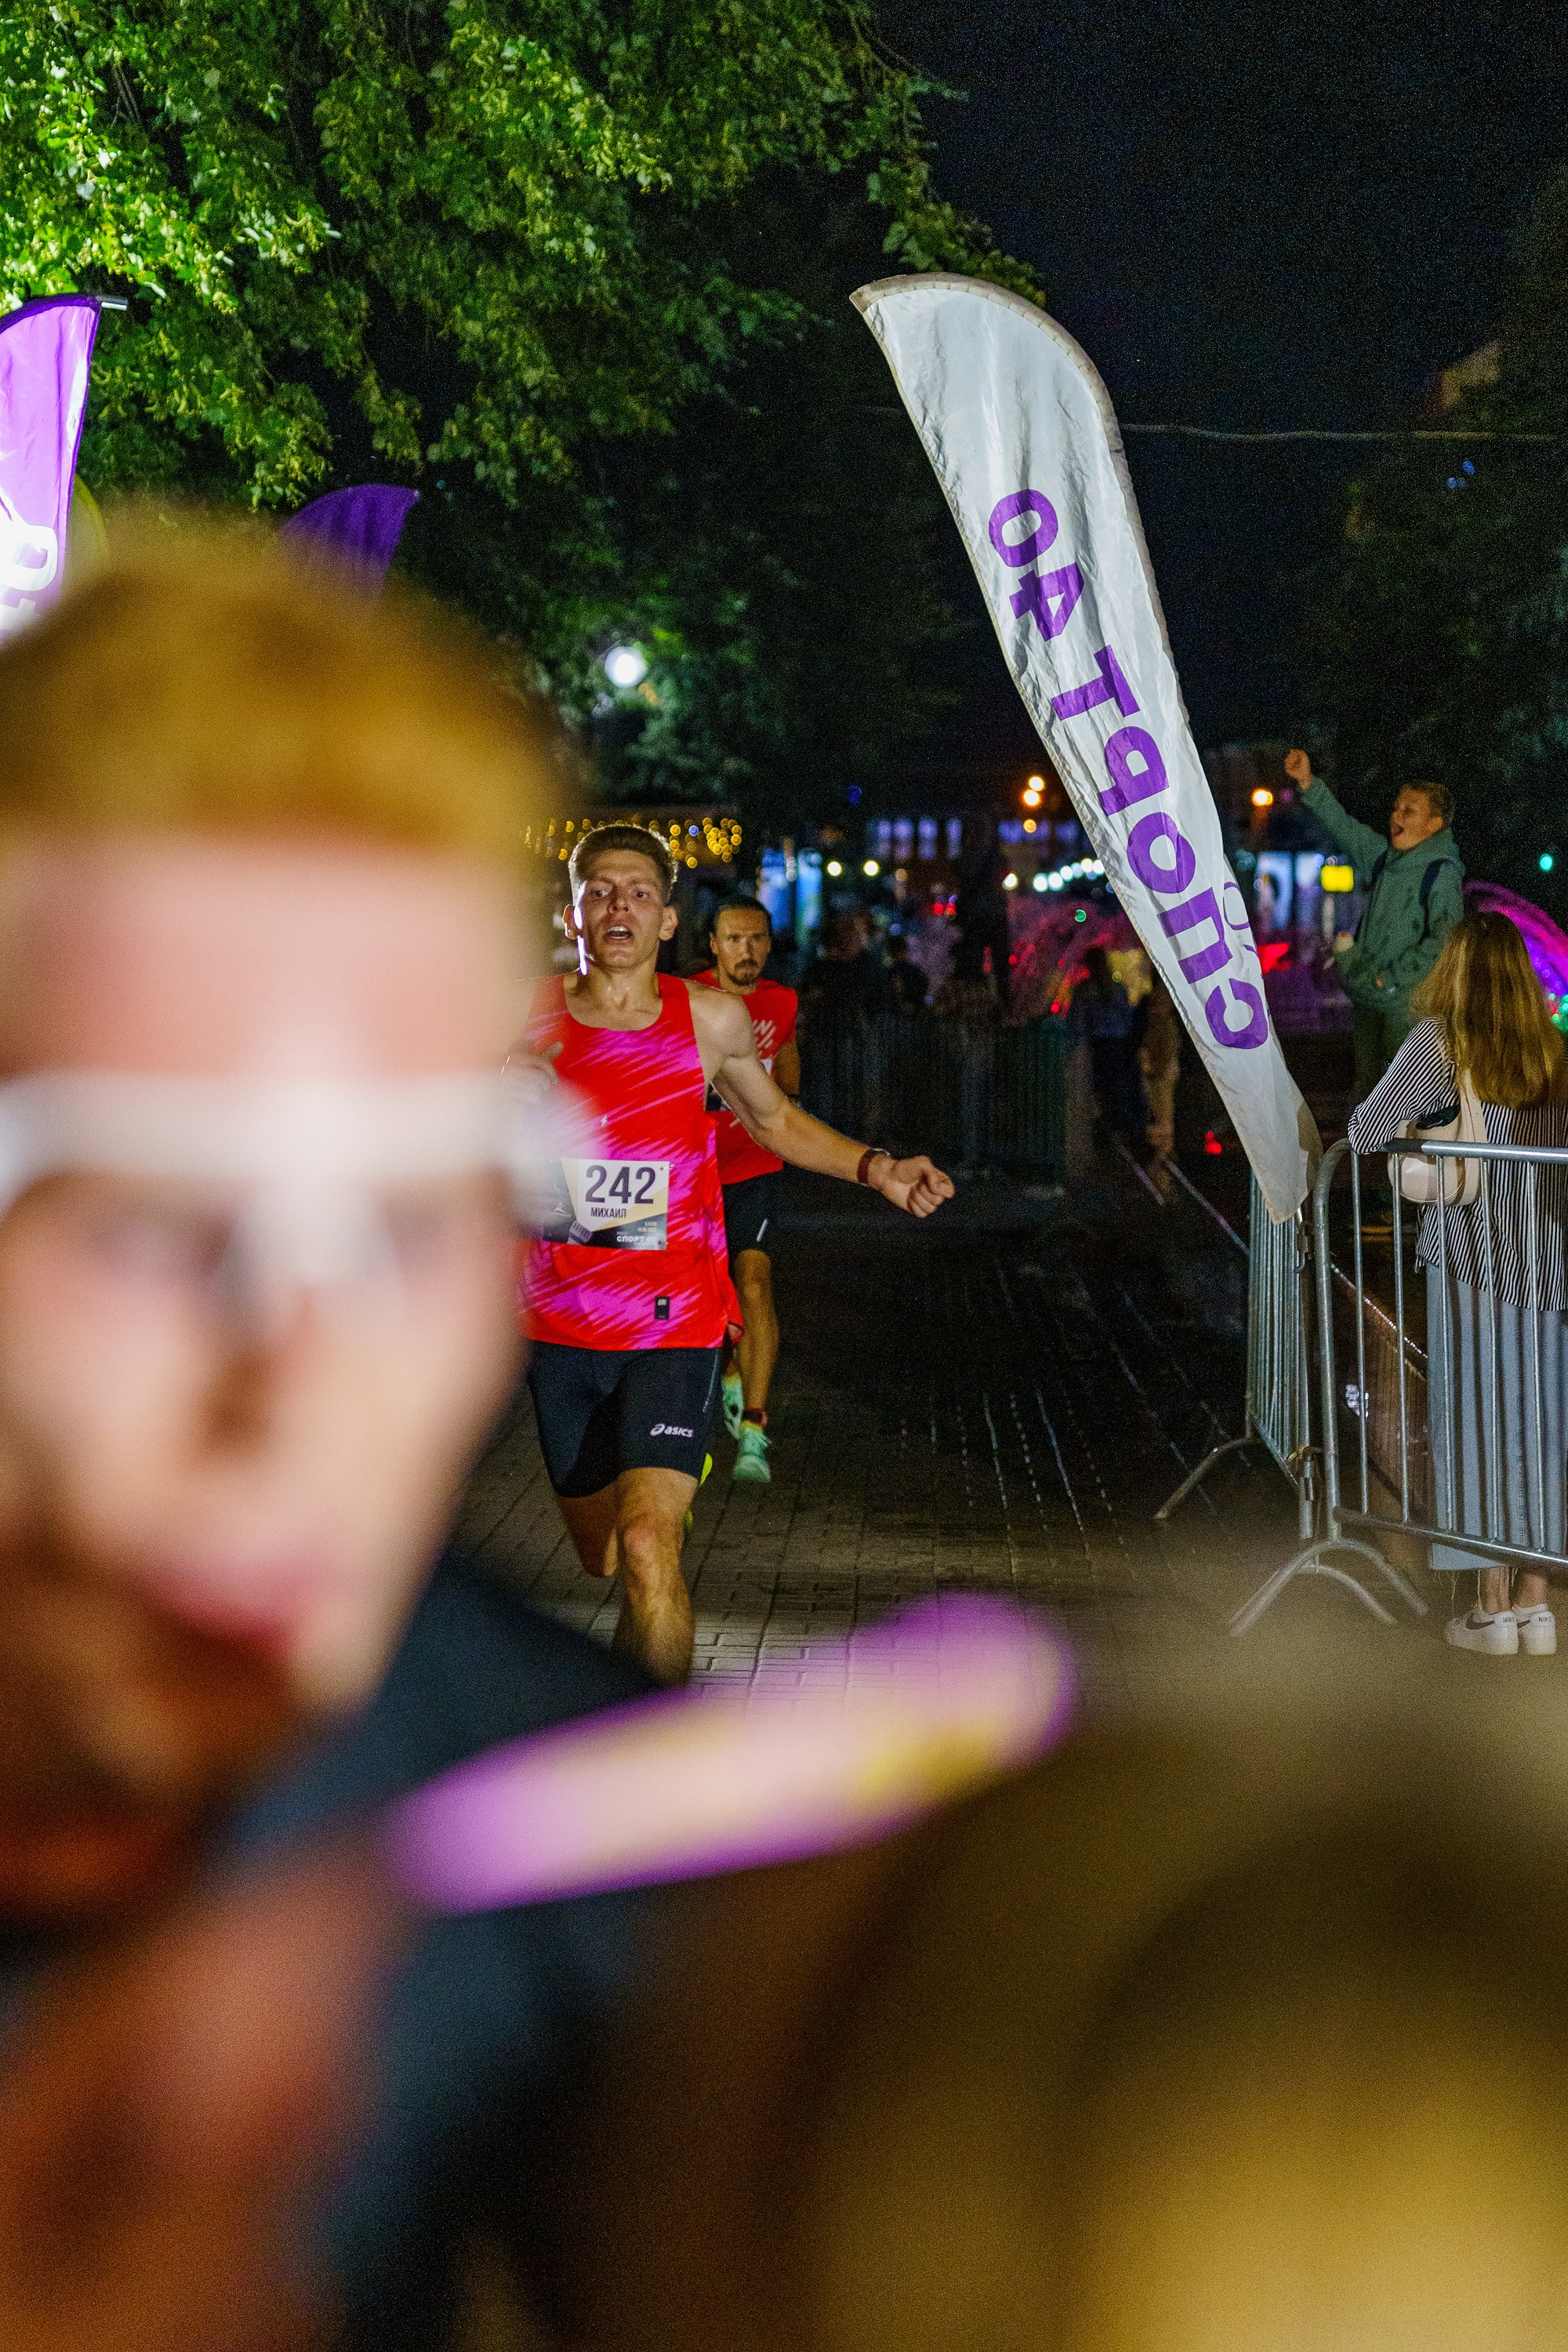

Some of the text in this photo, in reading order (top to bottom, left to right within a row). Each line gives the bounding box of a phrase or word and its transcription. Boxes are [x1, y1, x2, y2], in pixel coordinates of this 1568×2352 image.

[585, 1165, 656, 1204] 242
[590, 1207, 626, 1218] МИХАИЛ
[664, 1426, 693, 1437] asics
